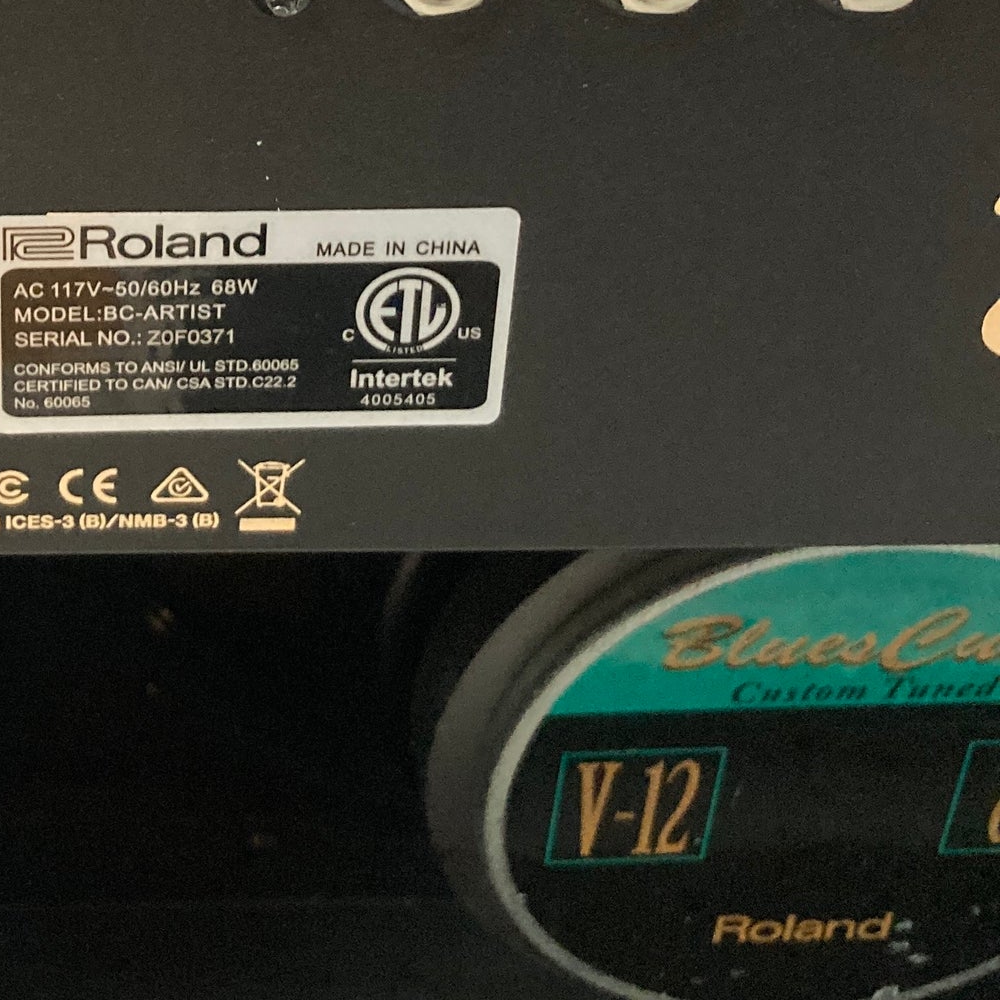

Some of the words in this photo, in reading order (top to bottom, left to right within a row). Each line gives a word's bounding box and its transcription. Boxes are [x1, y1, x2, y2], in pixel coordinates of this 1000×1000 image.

[79, 223, 268, 261] Roland
[316, 241, 375, 257] MADE
[385, 241, 405, 256] IN
[416, 239, 481, 255] CHINA
[13, 282, 45, 299] AC
[210, 277, 259, 296] 68W
[369, 277, 447, 344] ETL
[14, 330, 92, 348] SERIAL
[98, 330, 142, 346] NO.:
[13, 361, 111, 376] CONFORMS
[115, 361, 138, 374] TO
[190, 360, 210, 373] UL
[350, 367, 454, 389] Intertek
[13, 378, 101, 393] CERTIFIED
[105, 378, 129, 392] TO
[177, 377, 211, 389] CSA
[14, 396, 40, 409] No.
[44, 395, 91, 409] 60065
[360, 392, 436, 406] 4005405
[5, 514, 75, 529] ICES-3
[79, 511, 188, 531] (B)/NMB-3
[192, 511, 220, 530] (B)
[731, 679, 867, 704] Custom
[885, 674, 1000, 700] Tuned
[577, 759, 700, 858] V-12
[711, 912, 895, 945] Roland
